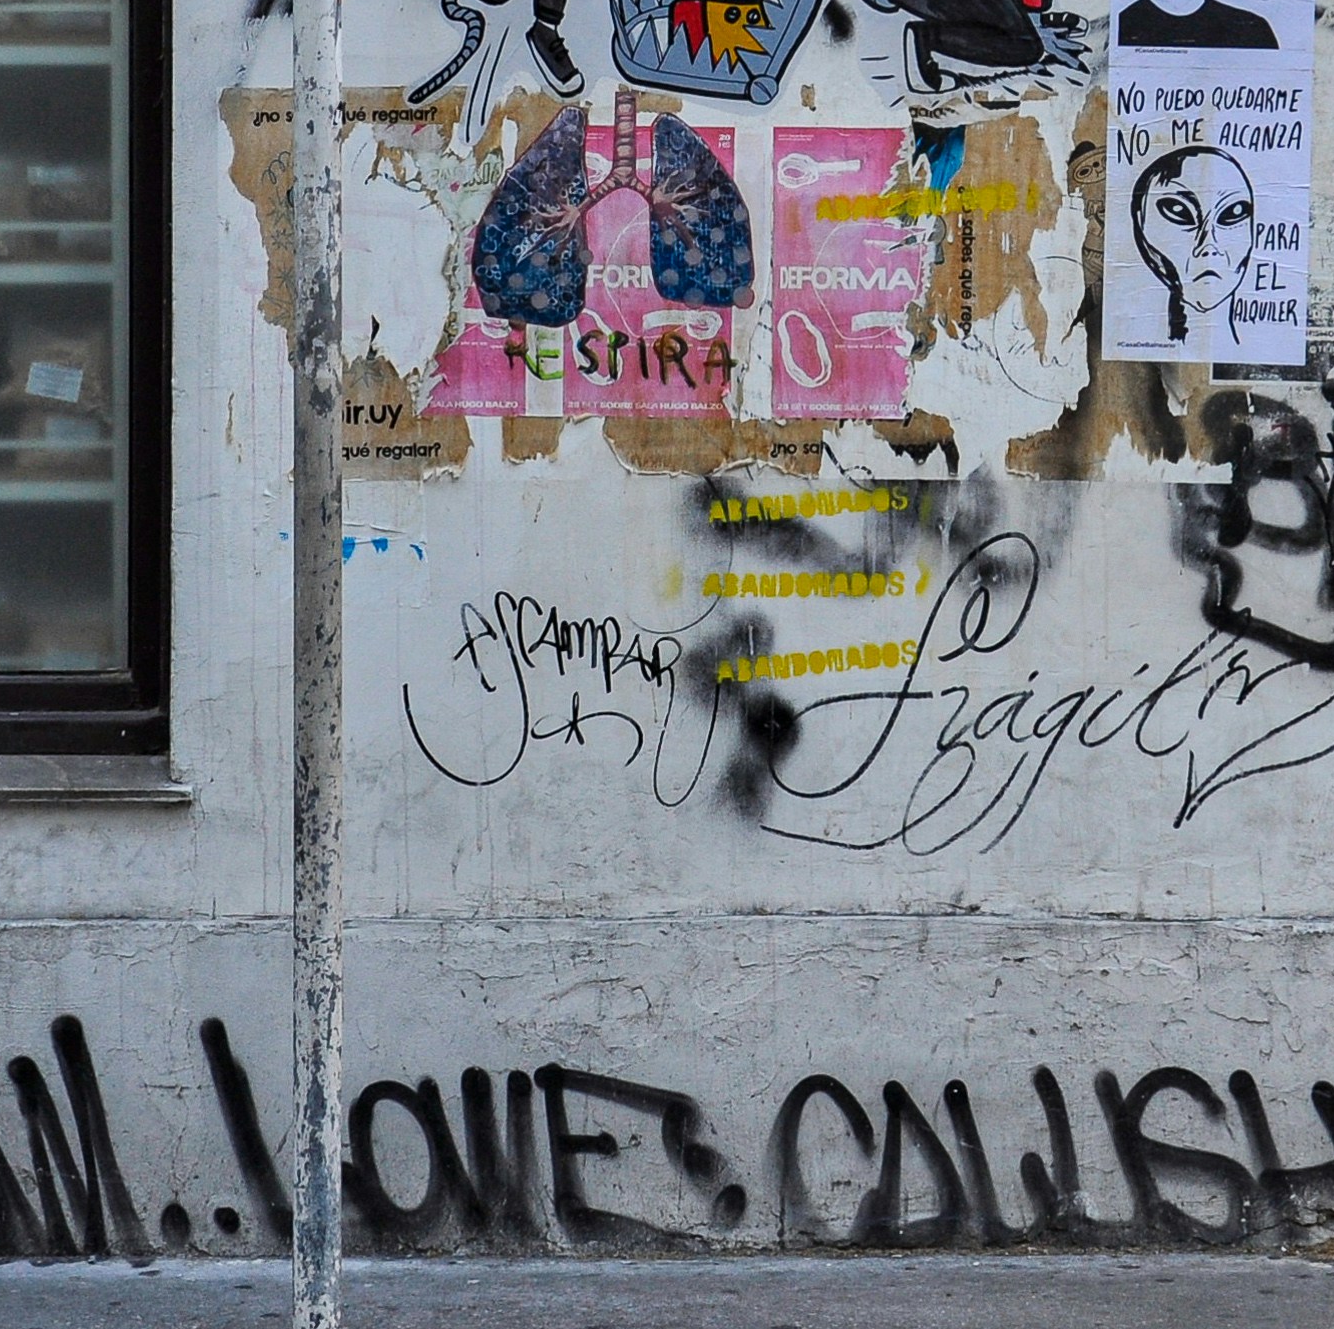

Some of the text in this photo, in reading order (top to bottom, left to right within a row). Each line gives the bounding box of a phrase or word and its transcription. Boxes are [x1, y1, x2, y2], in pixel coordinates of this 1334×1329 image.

[371, 105, 438, 124] regalar?
[1115, 82, 1304, 117] NO PUEDO QUEDARME
[1115, 118, 1304, 166] NO ME ALCANZA
[960, 218, 976, 263] sabes
[1255, 221, 1301, 254] PARA
[779, 265, 915, 291] DEFORMA
[958, 266, 976, 299] qué
[1255, 261, 1287, 291] EL
[1233, 298, 1299, 327] ALQUILER
[503, 328, 738, 389] RESPIRA
[342, 399, 404, 429] ir.uy
[659, 401, 689, 410] HUGO
[690, 401, 724, 411] BALZO
[342, 442, 441, 460] qué regalar?
[770, 442, 798, 458] ¿no
[708, 487, 909, 524] ABANDONADOS
[702, 570, 905, 598] ABANDONADOS
[717, 639, 919, 684] ABANDONADOS
